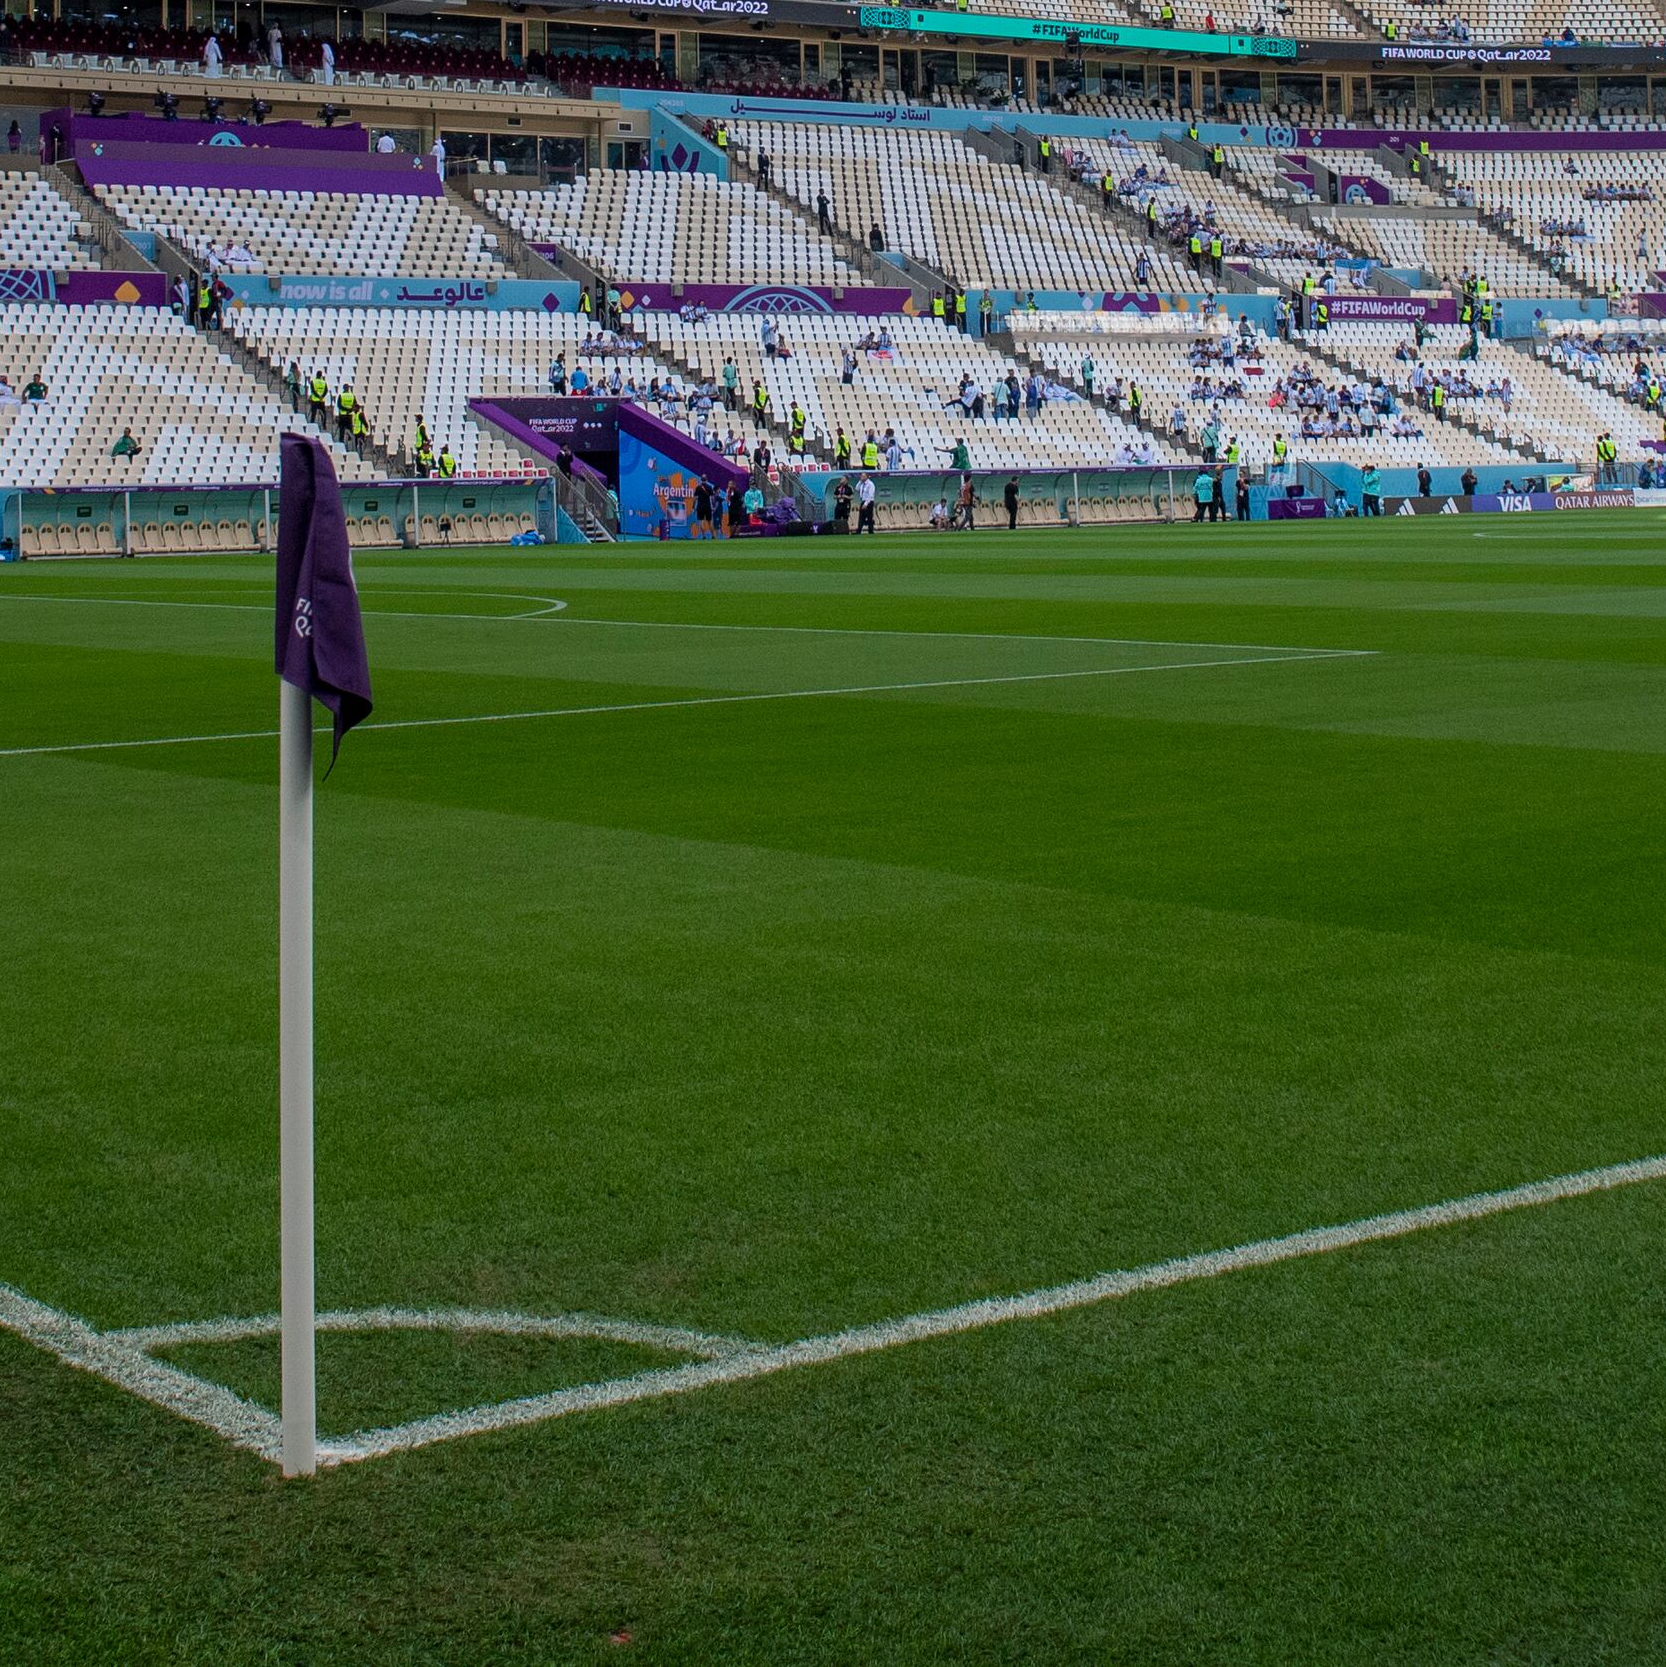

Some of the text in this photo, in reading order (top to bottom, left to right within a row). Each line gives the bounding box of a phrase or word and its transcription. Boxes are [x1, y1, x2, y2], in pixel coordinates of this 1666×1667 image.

[1381, 47, 1405, 58] FIFA
[1406, 47, 1444, 59] WORLD
[1446, 48, 1467, 60] CUP
[280, 280, 373, 301] now is all
[1331, 300, 1426, 316] #FIFAWorldCup
[653, 483, 695, 501] Argentin
[1497, 495, 1532, 512] VISA
[1555, 493, 1635, 511] QATAR AIRWAYS
